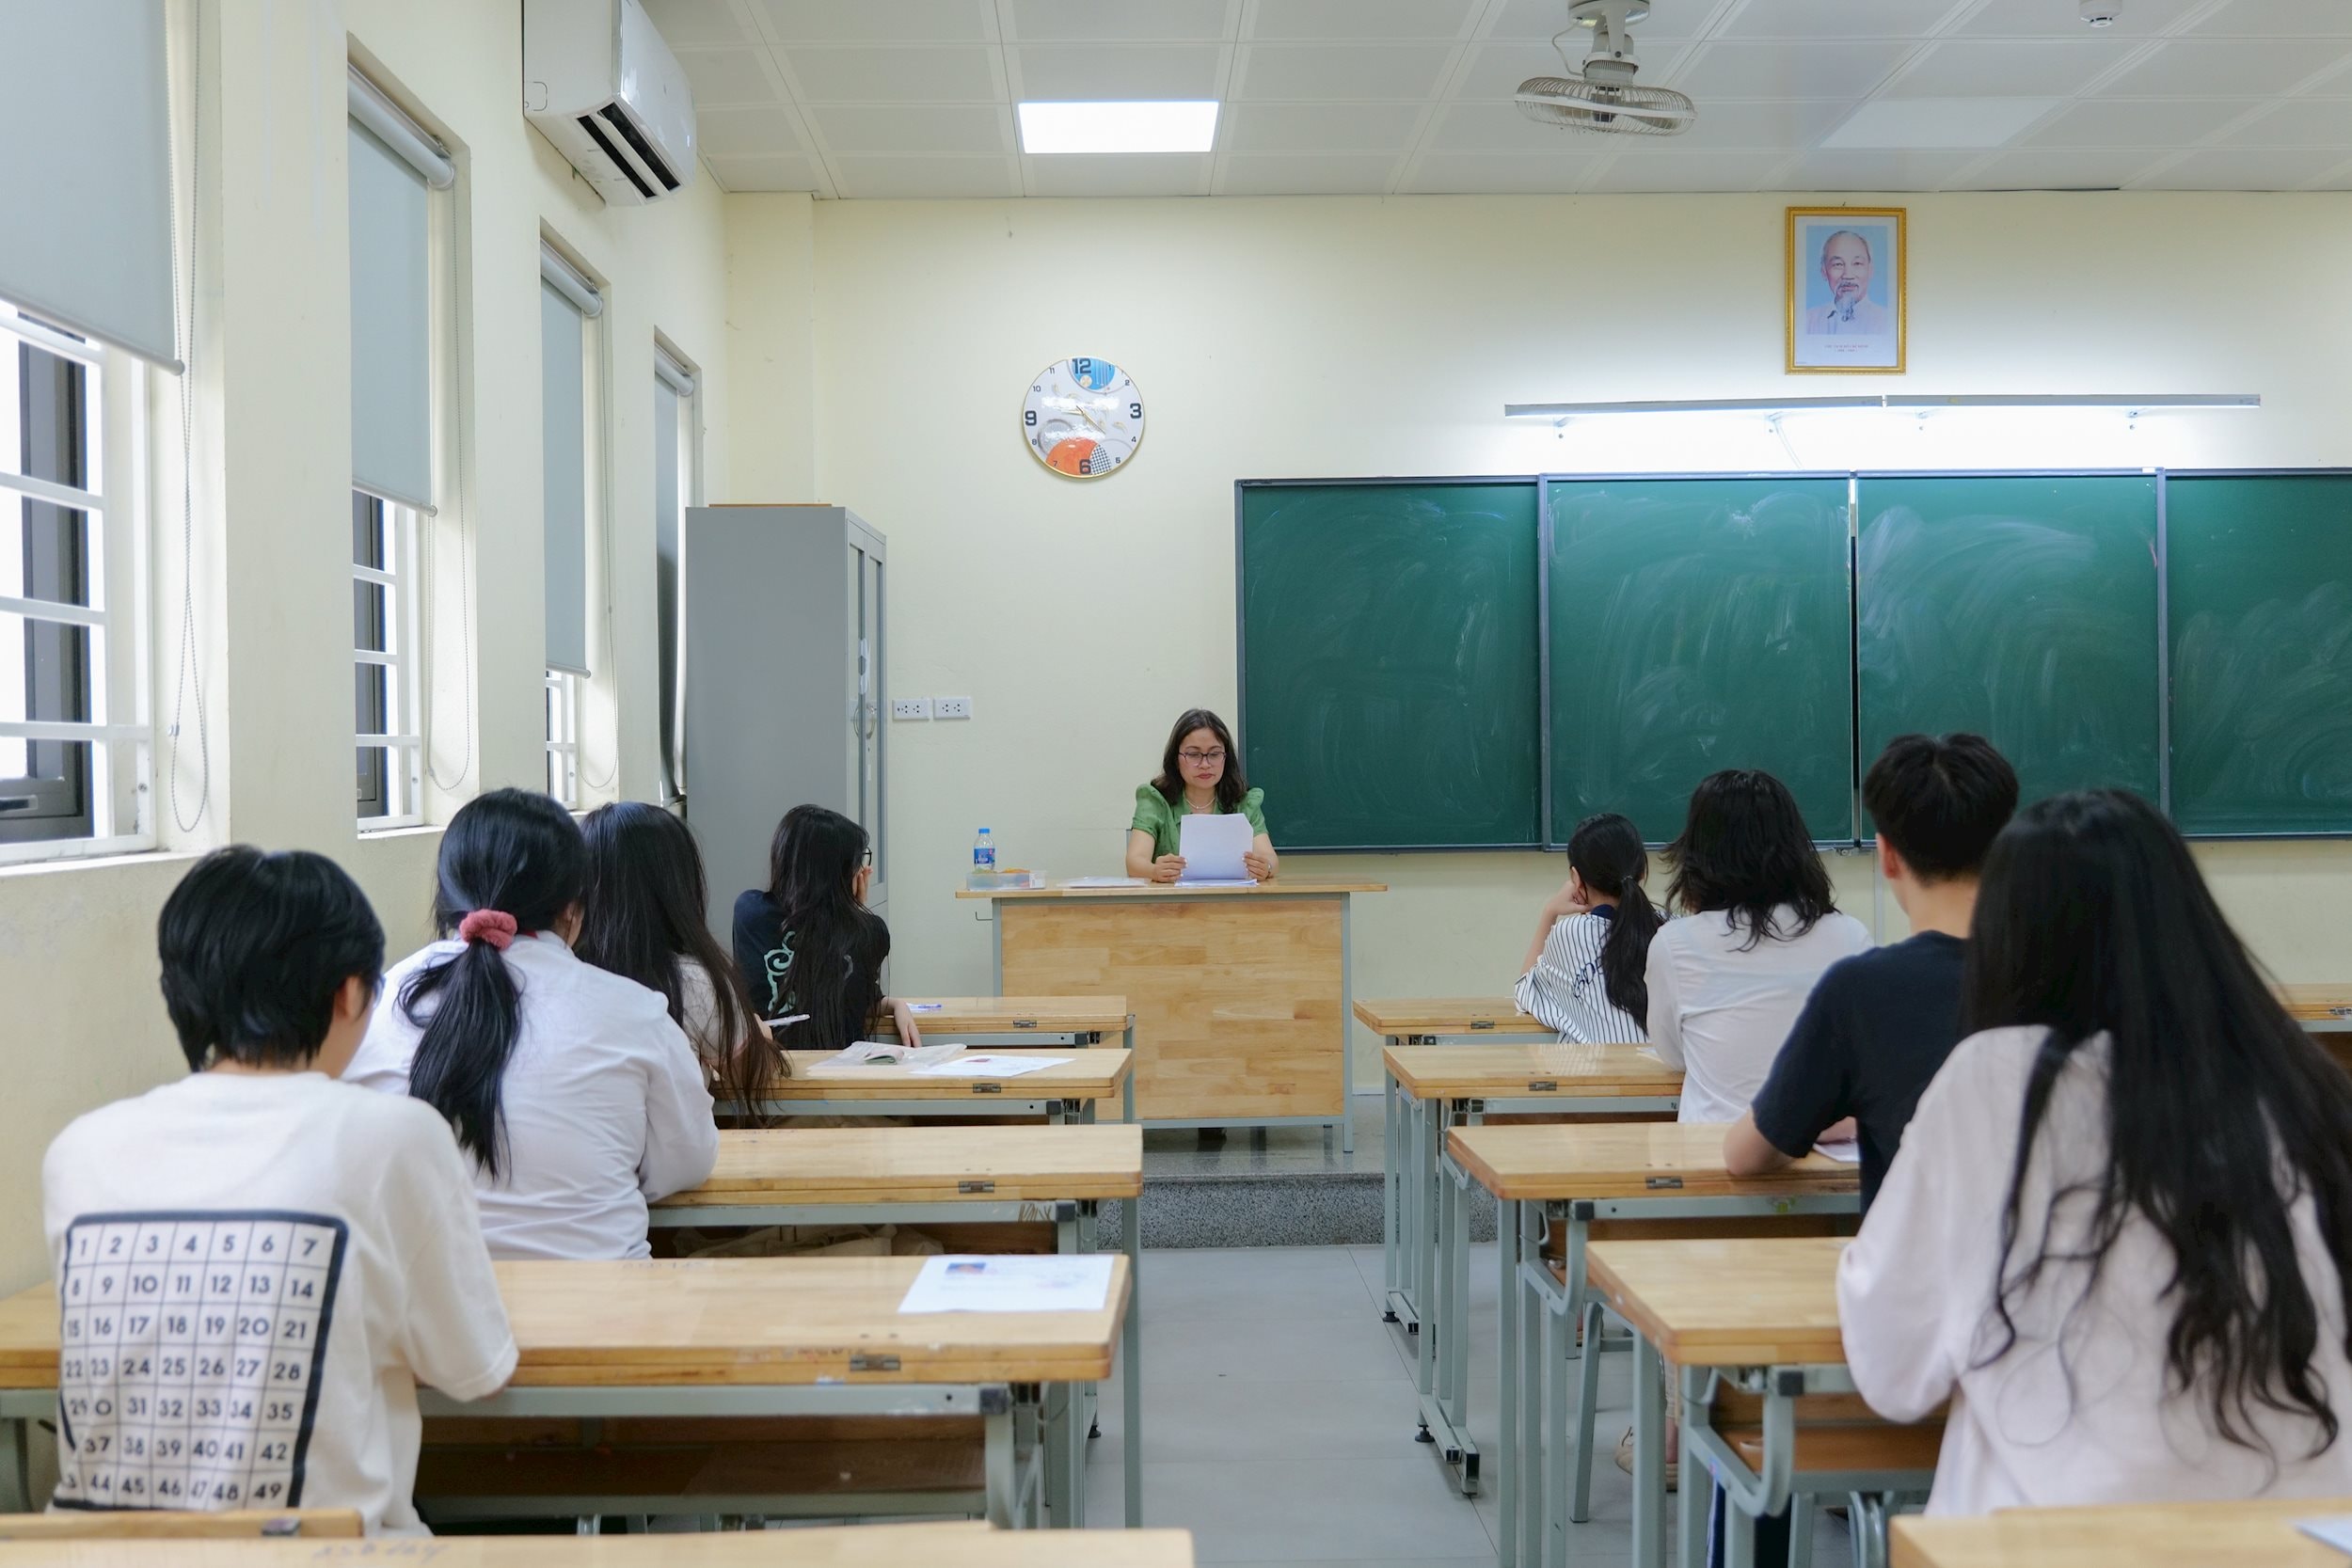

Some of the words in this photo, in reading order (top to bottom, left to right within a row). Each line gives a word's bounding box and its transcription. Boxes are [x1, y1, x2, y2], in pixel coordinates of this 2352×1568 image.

[1072, 357, 1091, 374] 12
[1025, 410, 1038, 426] 9
[1130, 403, 1142, 419] 3
[1079, 459, 1091, 475] 6
[81, 1238, 87, 1257] 1
[109, 1236, 122, 1254] 2
[146, 1234, 159, 1254] 3
[183, 1235, 197, 1253] 4
[223, 1234, 235, 1254] 5
[261, 1234, 275, 1254] 6
[302, 1238, 319, 1257] 7
[72, 1278, 81, 1296] 8
[103, 1275, 113, 1294] 9
[133, 1275, 158, 1293] 10
[176, 1275, 191, 1293] 11
[212, 1275, 231, 1293] 12
[250, 1275, 270, 1294] 13
[292, 1278, 313, 1299] 14
[68, 1319, 81, 1338] 15
[95, 1317, 112, 1335] 16
[130, 1317, 150, 1335] 17
[167, 1316, 187, 1335] 18
[205, 1317, 226, 1335] 19
[239, 1317, 269, 1337] 20
[284, 1320, 307, 1339] 21
[66, 1360, 83, 1379] 22
[91, 1357, 109, 1376] 23
[123, 1357, 151, 1376] 24
[163, 1357, 186, 1376] 25
[199, 1357, 225, 1376] 26
[236, 1357, 261, 1377] 27
[274, 1361, 300, 1381] 28
[128, 1397, 147, 1415] 31
[158, 1399, 183, 1418] 32
[197, 1399, 222, 1418] 33
[230, 1401, 252, 1419] 34
[266, 1402, 293, 1420] 35
[85, 1436, 110, 1453] 37
[123, 1436, 144, 1455] 38
[156, 1439, 182, 1457] 39
[193, 1440, 218, 1458] 40
[225, 1443, 244, 1460] 41
[262, 1443, 287, 1461] 42
[90, 1473, 110, 1491] 44
[122, 1477, 144, 1494] 45
[158, 1479, 182, 1496] 46
[191, 1481, 208, 1498] 47
[213, 1482, 239, 1500] 48
[253, 1482, 282, 1499] 49
